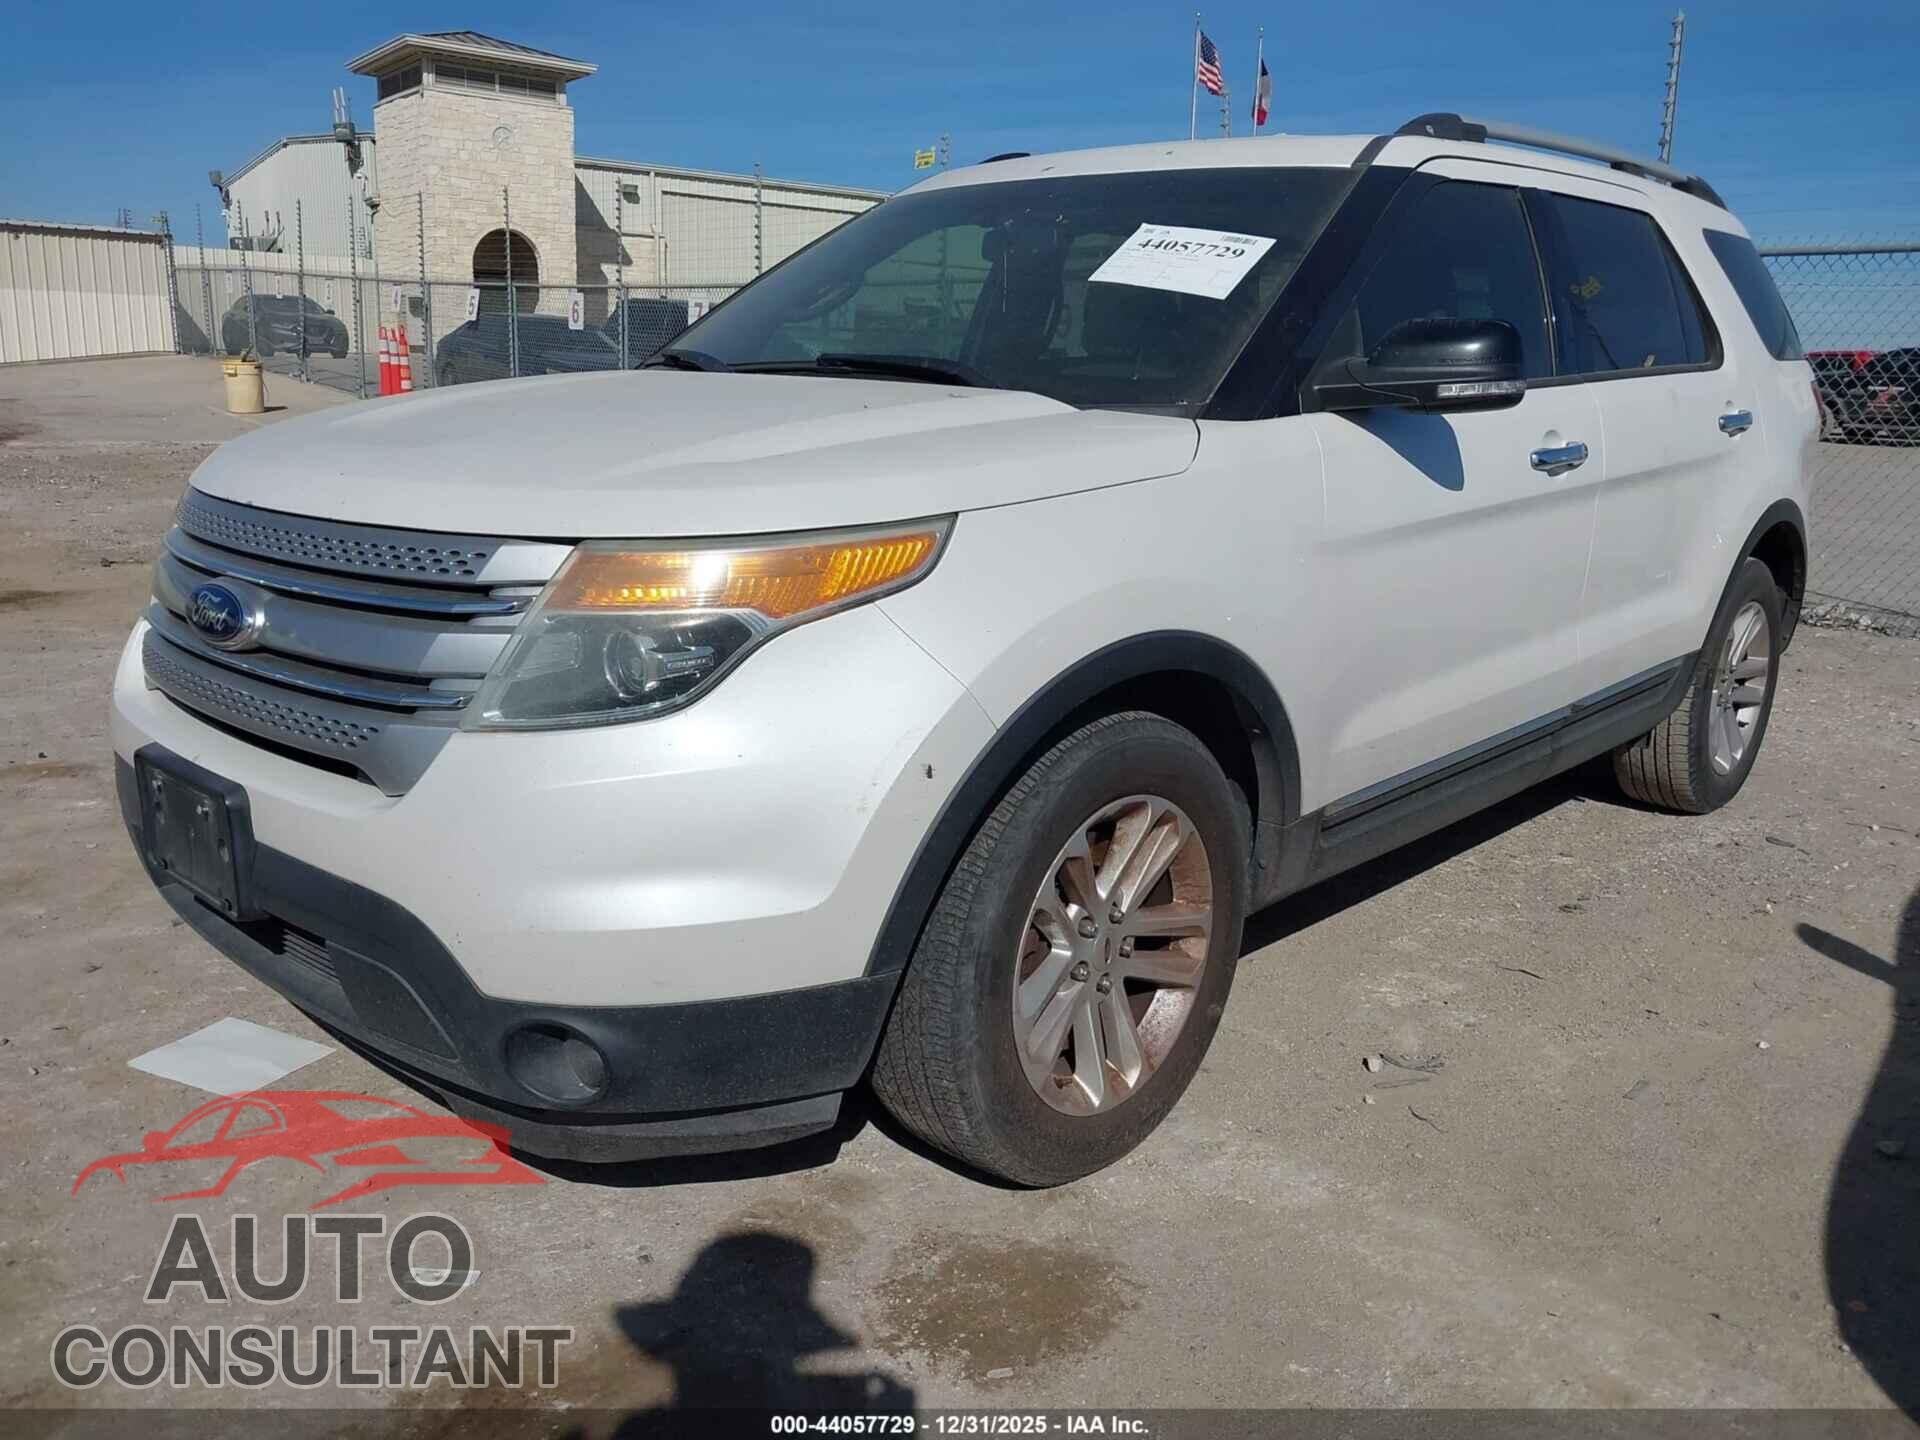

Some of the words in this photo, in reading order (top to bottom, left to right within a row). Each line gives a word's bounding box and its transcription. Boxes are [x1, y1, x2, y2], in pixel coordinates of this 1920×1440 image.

[1138, 239, 1246, 258] 44057729
[572, 300, 580, 324] 6
[192, 591, 229, 631] Ford
